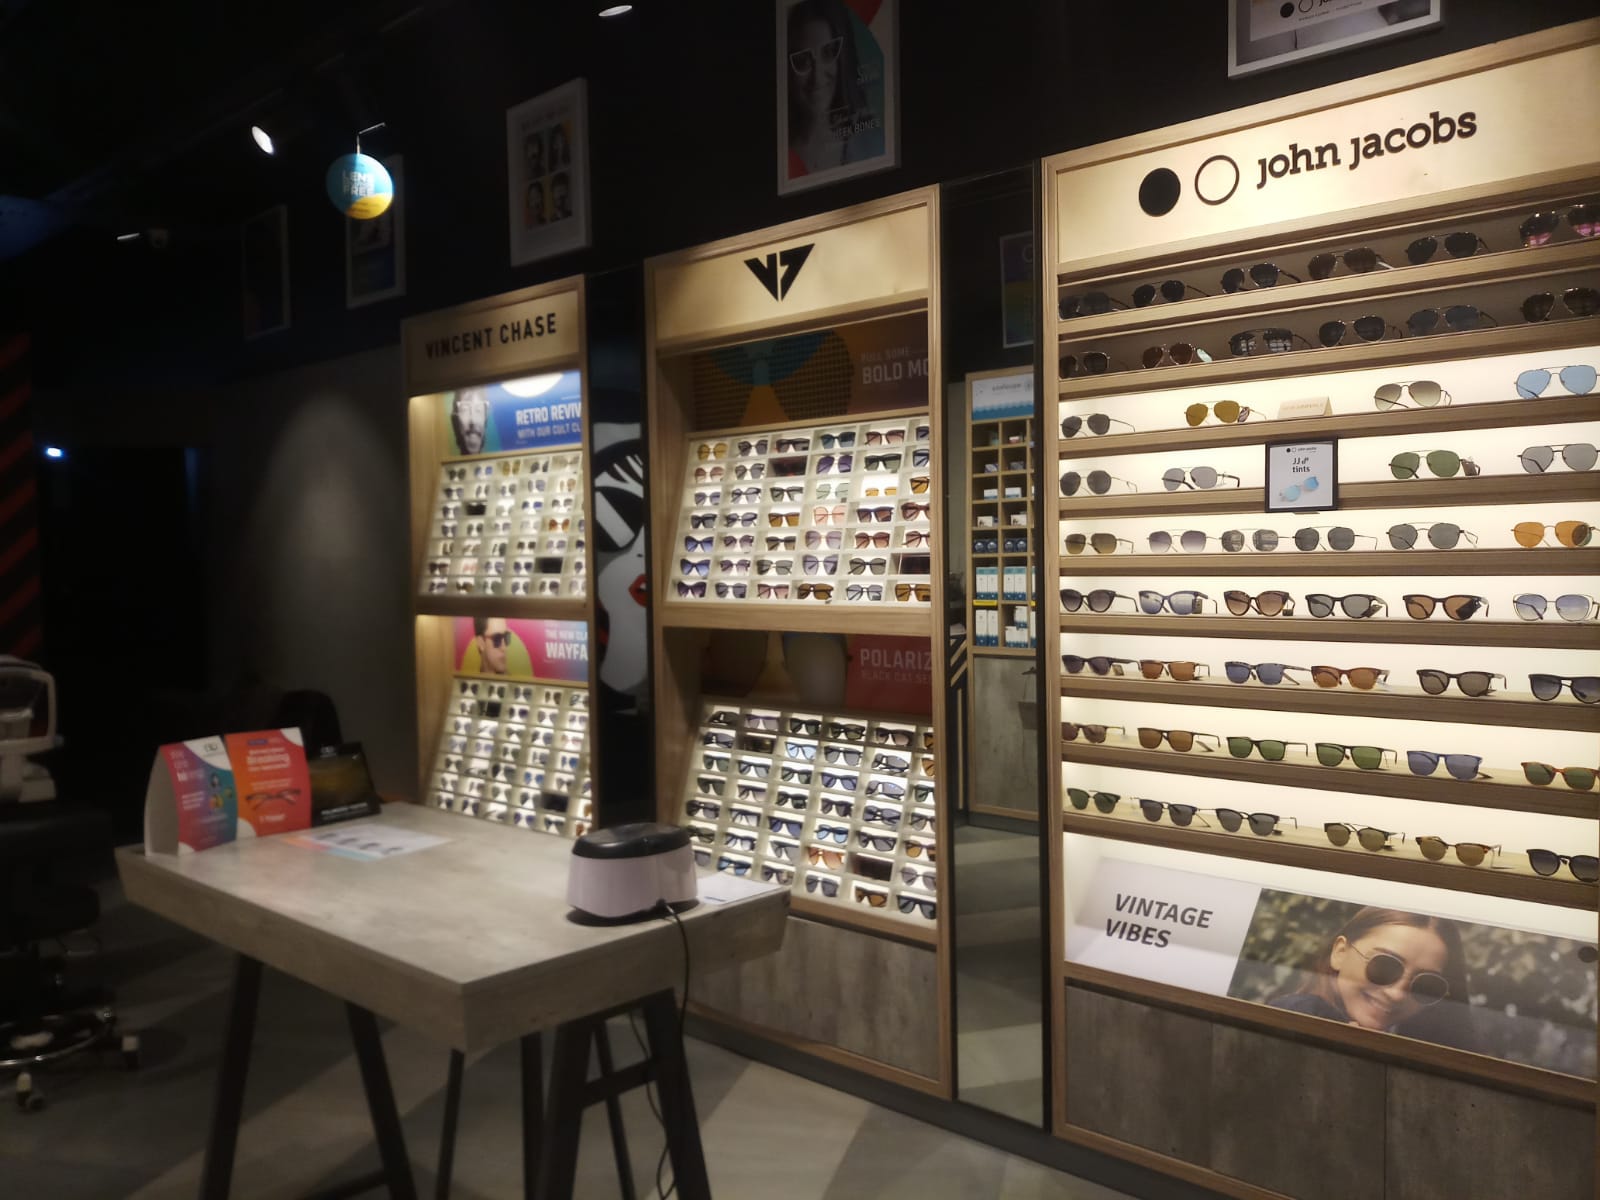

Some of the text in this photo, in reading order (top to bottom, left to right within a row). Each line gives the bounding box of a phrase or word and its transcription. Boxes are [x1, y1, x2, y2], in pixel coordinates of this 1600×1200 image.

[1257, 111, 1477, 189] john jacobs
[425, 312, 557, 359] VINCENT CHASE
[862, 363, 902, 385] BOLD
[516, 407, 549, 425] RETRO
[546, 642, 588, 661] WAYFA
[860, 649, 931, 670] POLARIZ
[1114, 893, 1214, 929] VINTAGE
[1105, 917, 1172, 949] VIBES
